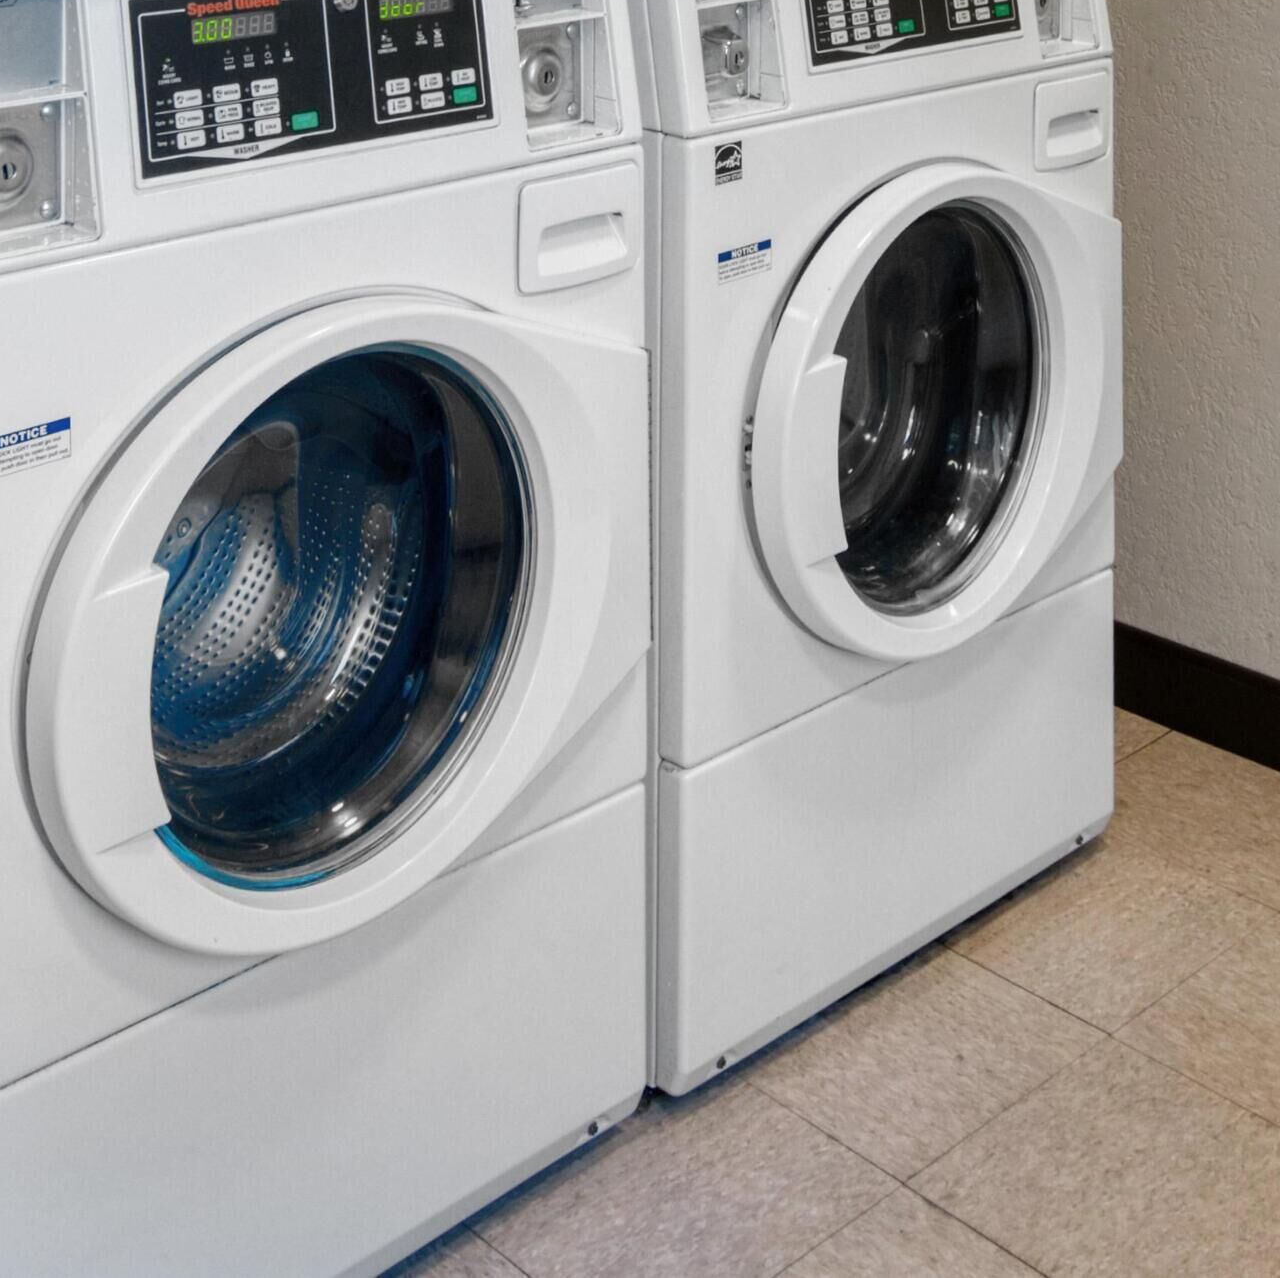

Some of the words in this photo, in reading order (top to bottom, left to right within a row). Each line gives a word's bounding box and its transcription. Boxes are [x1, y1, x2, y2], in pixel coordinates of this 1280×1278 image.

[234, 144, 260, 155] WASHER
[730, 242, 758, 259] NOTICE
[0, 424, 48, 448] NOTICE
